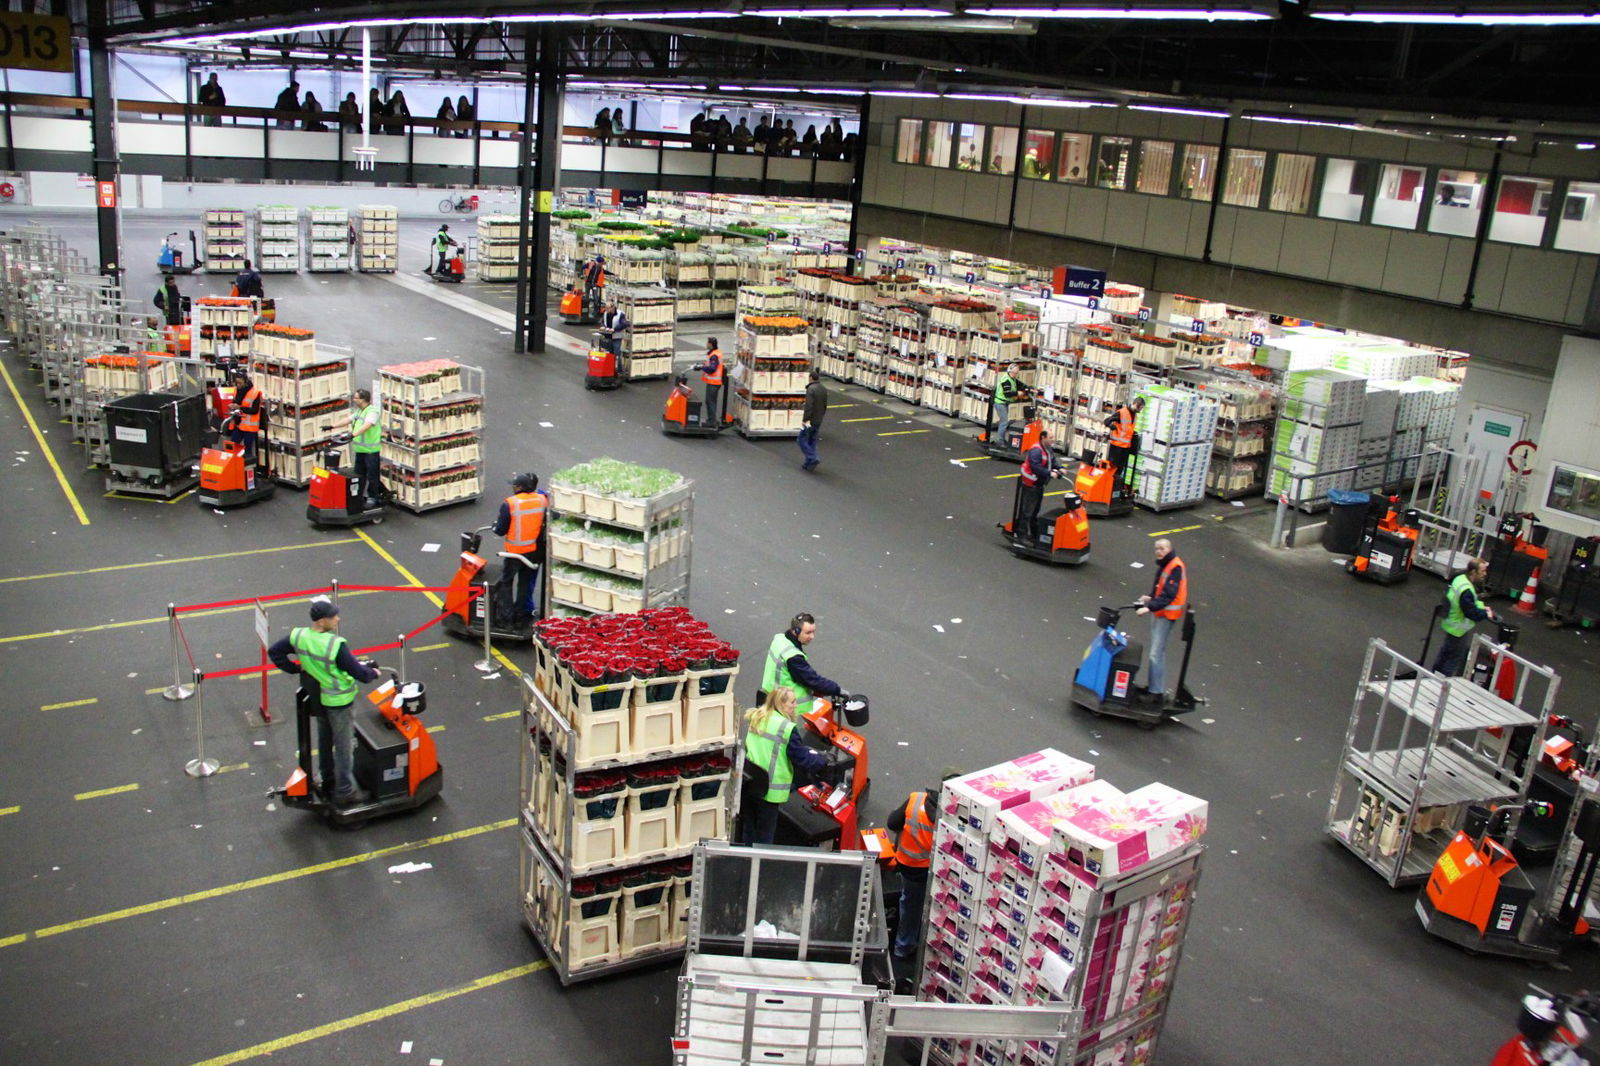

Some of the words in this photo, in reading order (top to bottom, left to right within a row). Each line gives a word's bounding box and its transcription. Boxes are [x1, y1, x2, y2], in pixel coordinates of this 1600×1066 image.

[928, 267, 933, 275] 6
[967, 274, 973, 282] 7
[1069, 280, 1091, 289] Buffer
[1091, 278, 1100, 290] 2
[1043, 289, 1048, 298] 8
[1090, 300, 1096, 308] 9
[1138, 310, 1148, 321] 10
[1193, 322, 1203, 332] 11
[1250, 335, 1262, 345] 12
